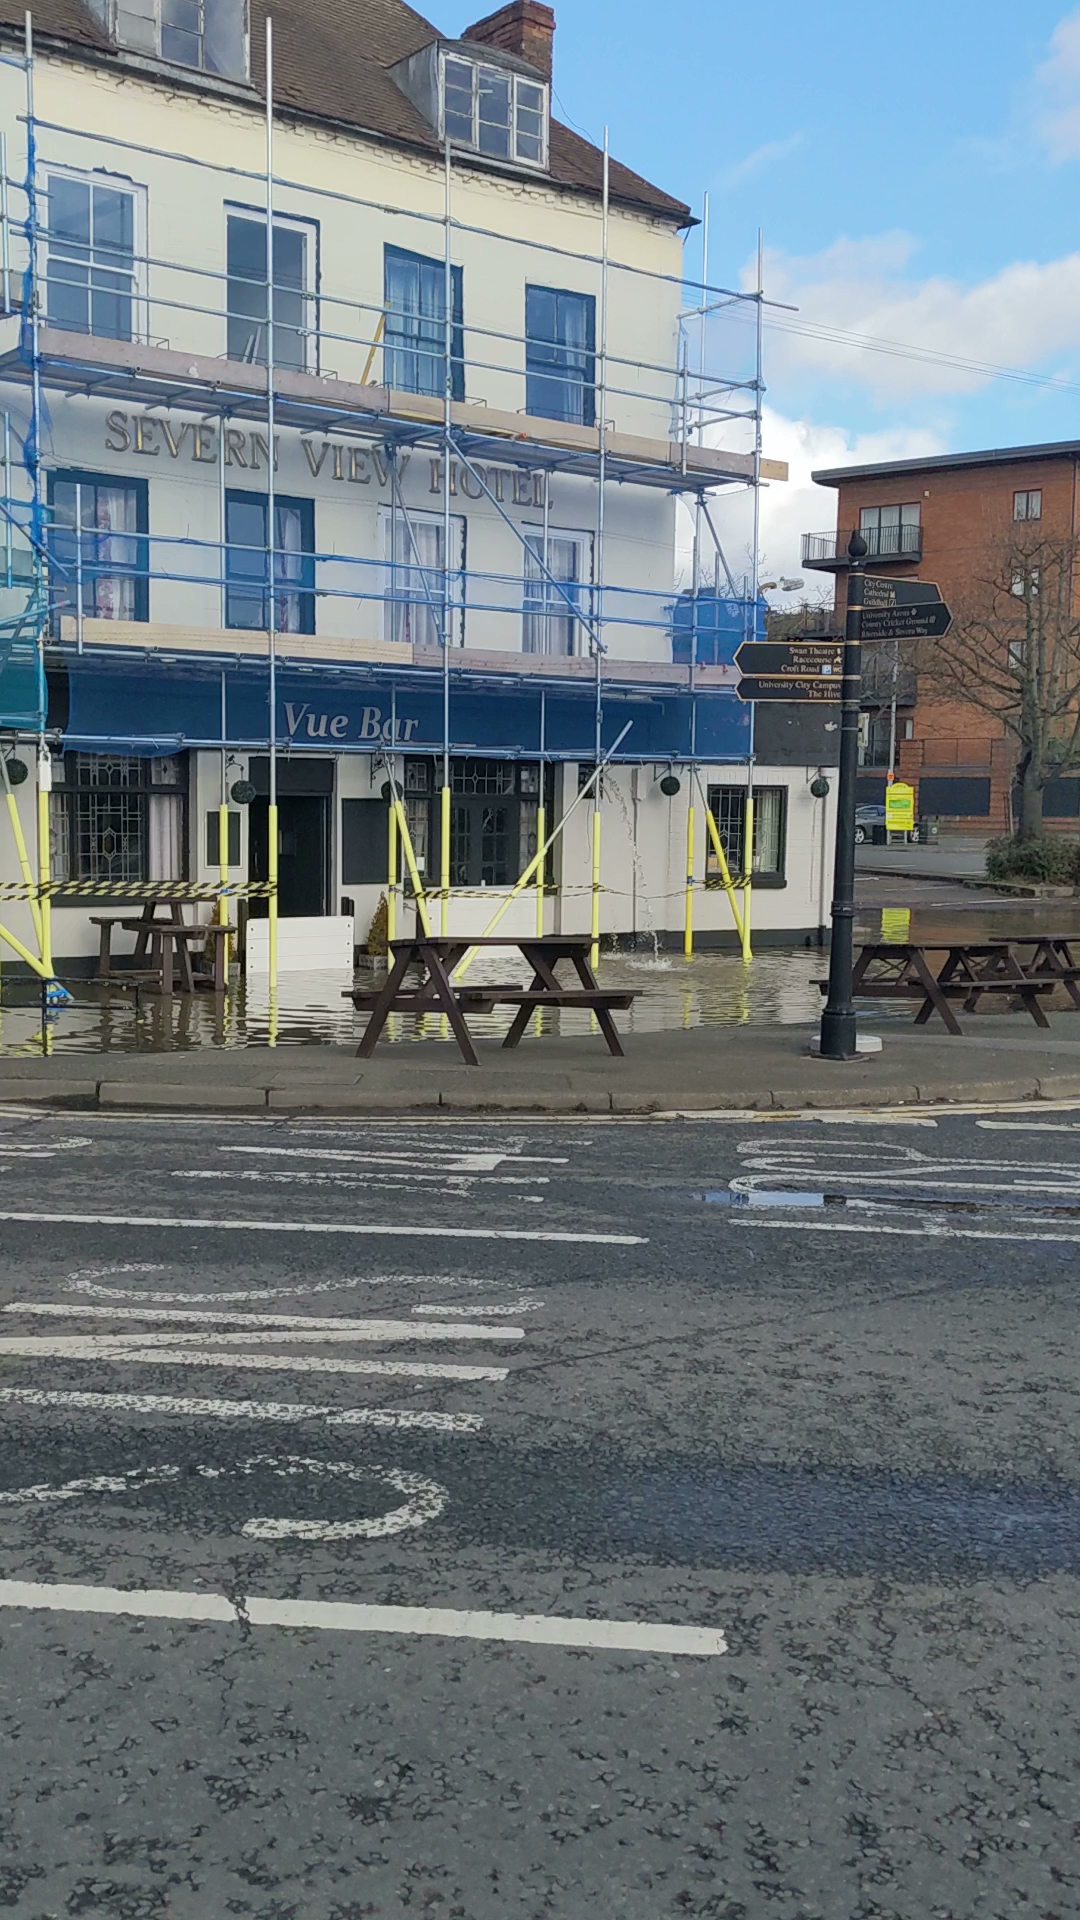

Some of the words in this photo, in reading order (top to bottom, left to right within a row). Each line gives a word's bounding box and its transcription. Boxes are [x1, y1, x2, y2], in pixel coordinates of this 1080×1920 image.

[105, 410, 280, 472] SEVERN
[301, 438, 411, 487] VIEW
[429, 457, 553, 509] HOTEL
[876, 580, 893, 589] Centre
[864, 588, 889, 597] Cathedral
[906, 617, 928, 625] Ground
[916, 627, 928, 635] Way
[808, 647, 835, 655] Theatre
[780, 665, 800, 673] Croft
[801, 665, 820, 673] Road
[758, 681, 794, 690] University
[795, 681, 811, 690] City
[812, 681, 841, 690] Campus
[808, 690, 822, 698] The
[824, 690, 841, 698] Hive
[283, 702, 349, 738] Vue
[358, 706, 419, 740] Bar
